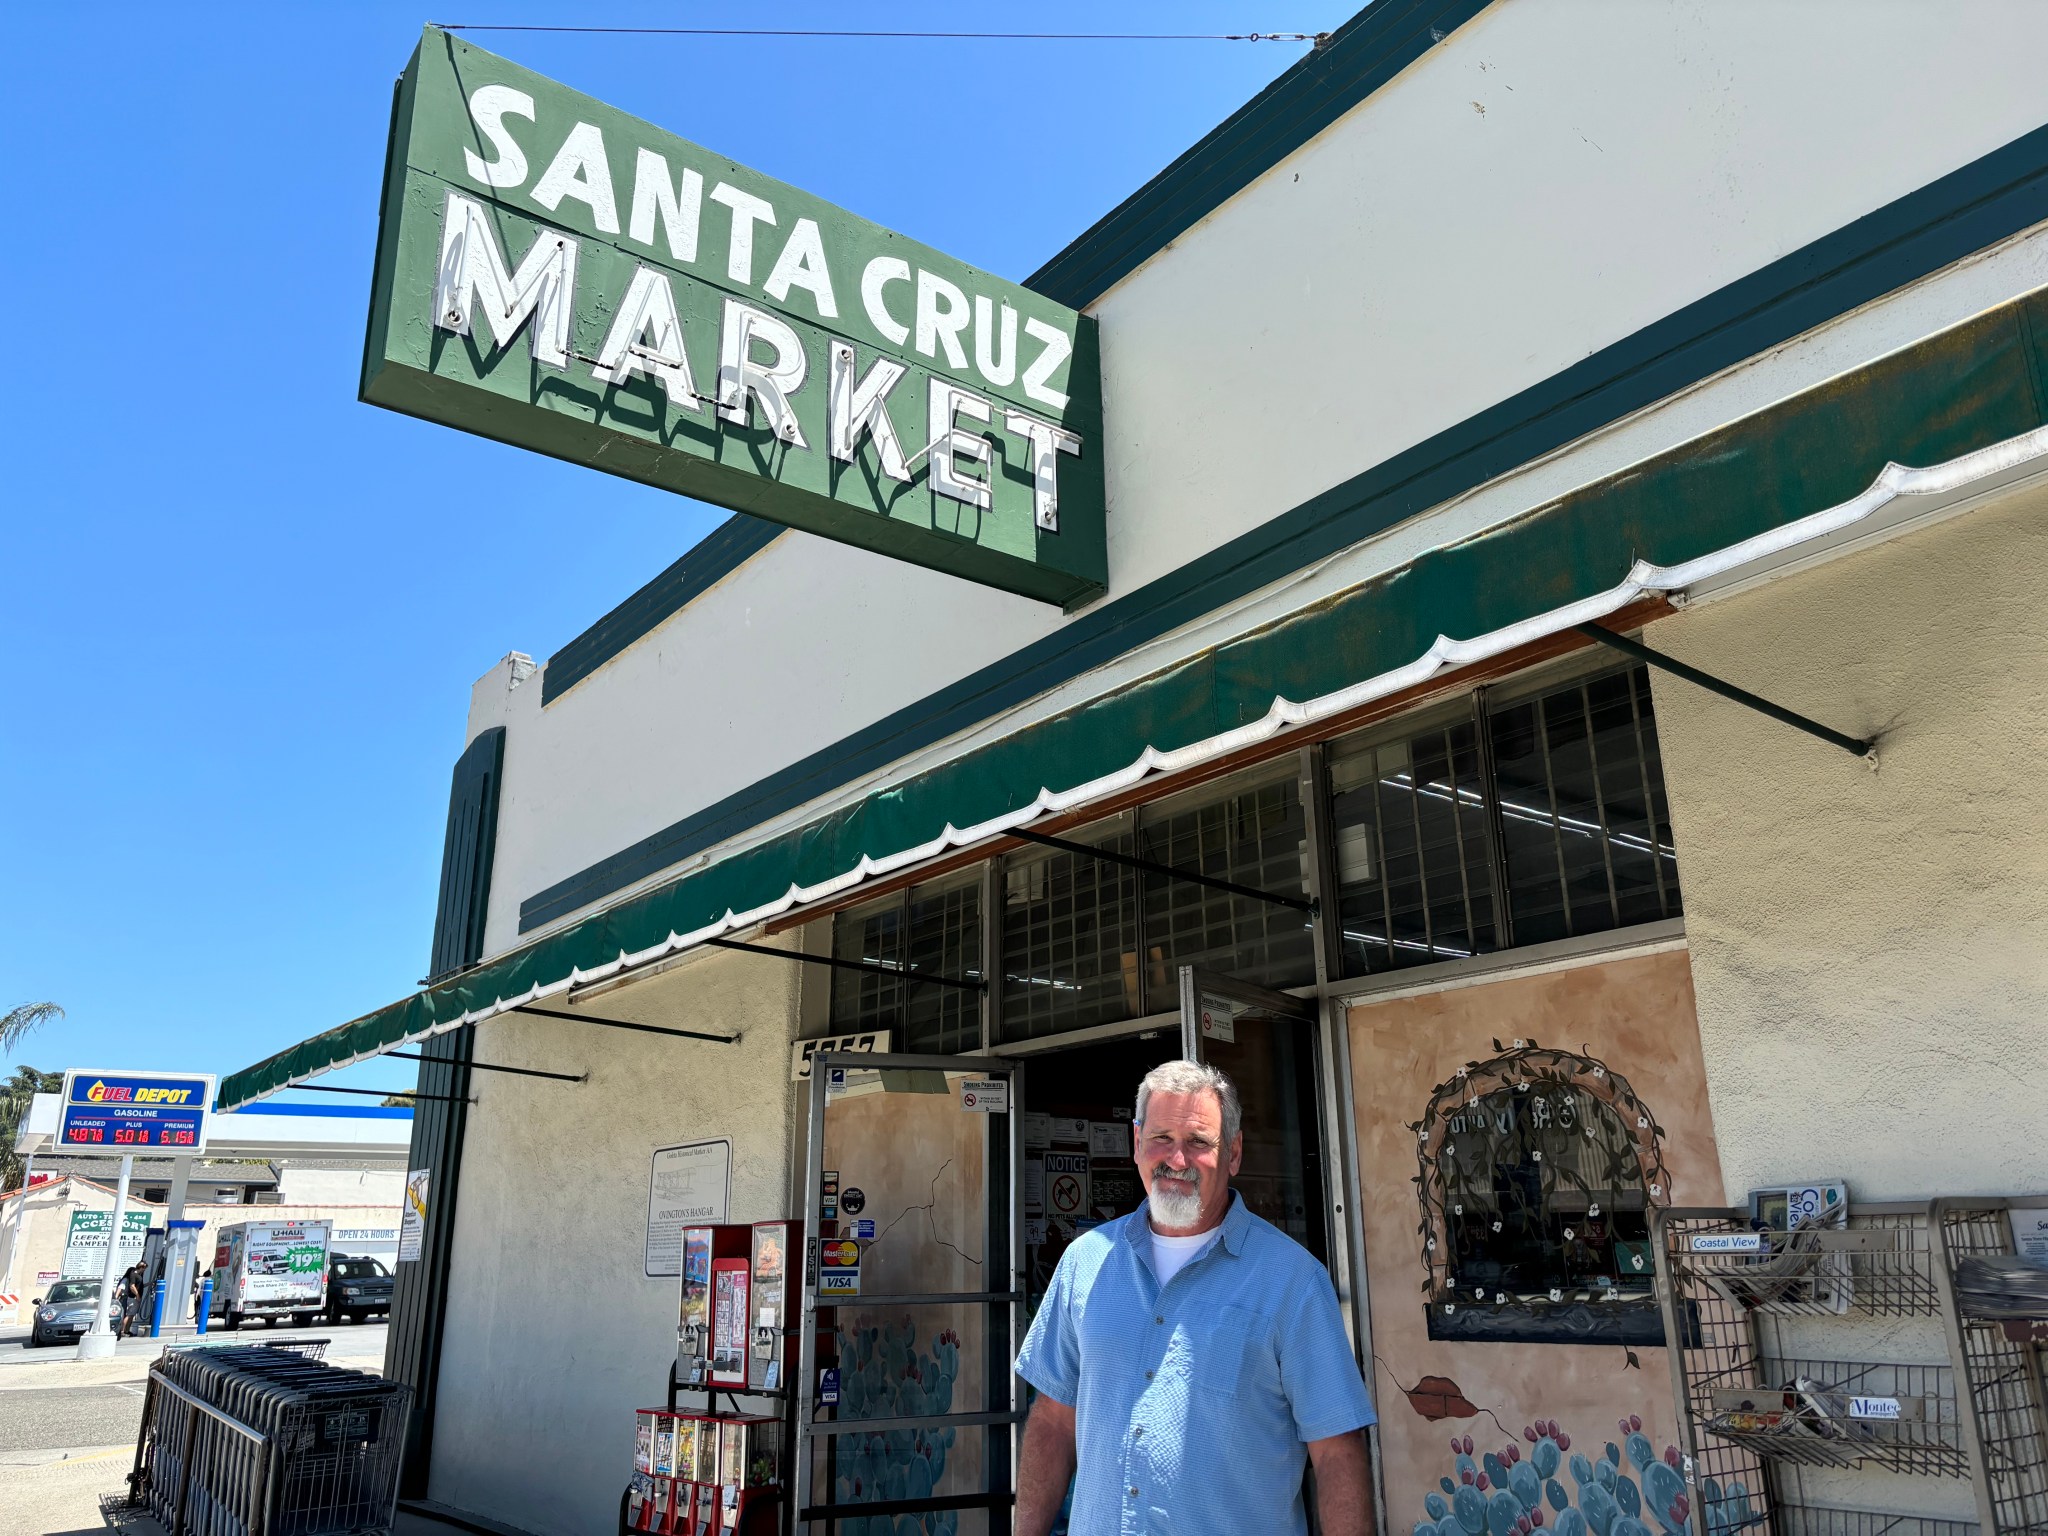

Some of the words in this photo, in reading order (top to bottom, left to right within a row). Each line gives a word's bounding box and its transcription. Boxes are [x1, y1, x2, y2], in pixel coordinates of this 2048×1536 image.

[463, 84, 837, 319] SANTA
[860, 255, 1072, 410] CRUZ
[433, 190, 1083, 533] MARKET
[91, 1086, 132, 1101] FUEL
[134, 1088, 192, 1103] DEPOT
[114, 1109, 158, 1117] GASOLINE
[1047, 1156, 1086, 1172] NOTICE
[659, 1209, 690, 1220] OVINGTON'S
[690, 1206, 714, 1218] HANGAR
[72, 1220, 148, 1231] ACCESORY
[339, 1230, 358, 1239] OPEN
[360, 1230, 368, 1238] 24
[370, 1230, 394, 1238] HOURS
[1694, 1238, 1729, 1249] Coastal
[1732, 1237, 1757, 1247] View
[808, 1241, 816, 1272] PUSH
[827, 1278, 852, 1288] VISA
